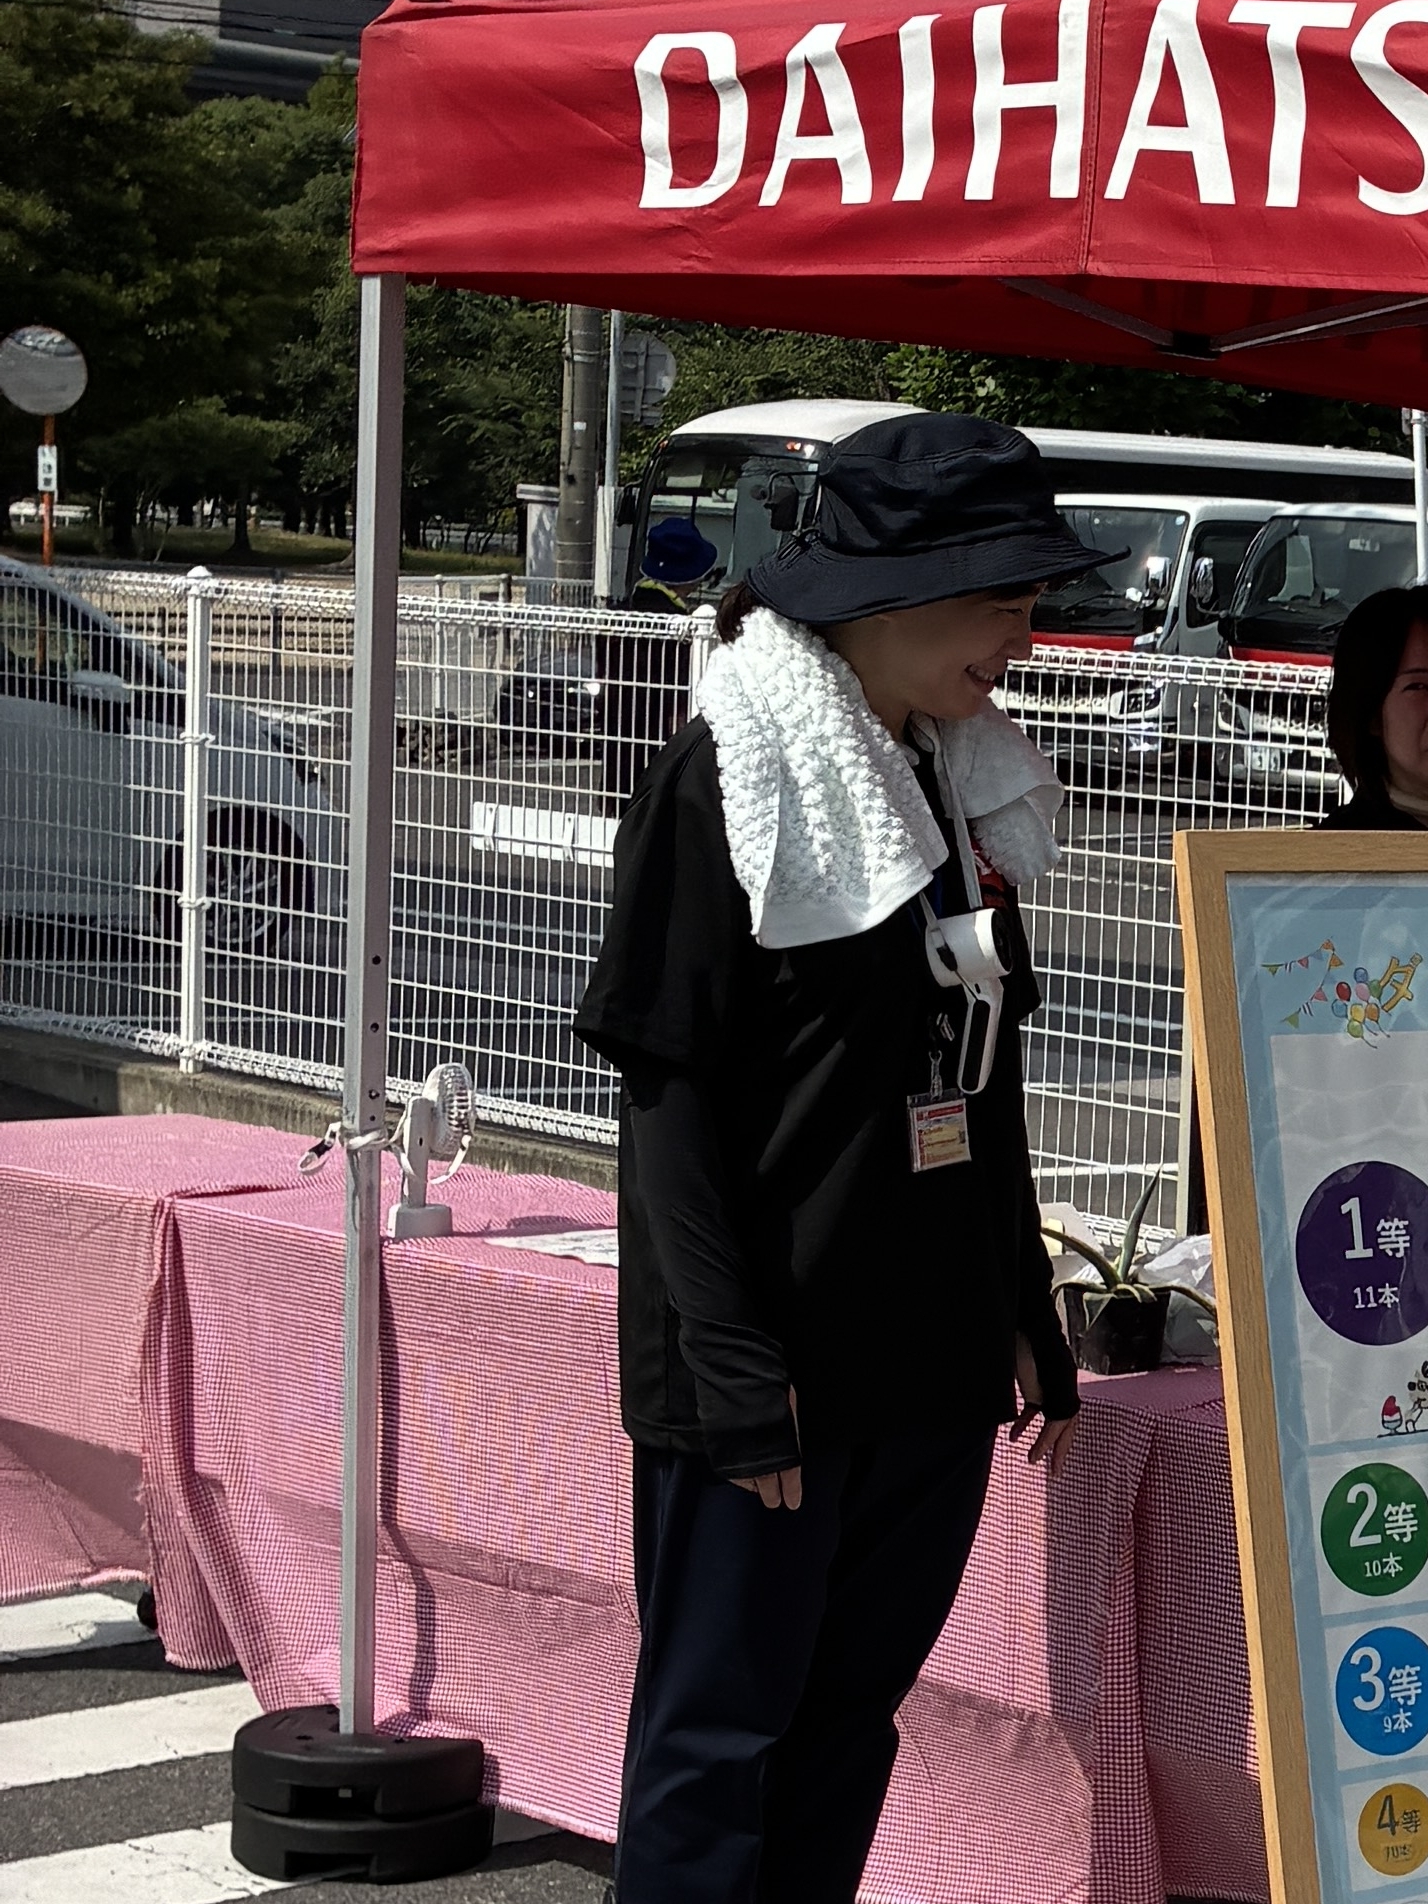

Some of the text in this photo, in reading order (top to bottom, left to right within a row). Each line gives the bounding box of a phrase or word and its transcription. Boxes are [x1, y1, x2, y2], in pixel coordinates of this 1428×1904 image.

[1340, 1196, 1411, 1260] 1等
[1353, 1282, 1399, 1309] 11本
[1346, 1482, 1418, 1547] 2等
[1364, 1551, 1403, 1578] 10本
[1350, 1646, 1422, 1712] 3等
[1383, 1708, 1413, 1734] 9本
[1377, 1794, 1421, 1837] 4等
